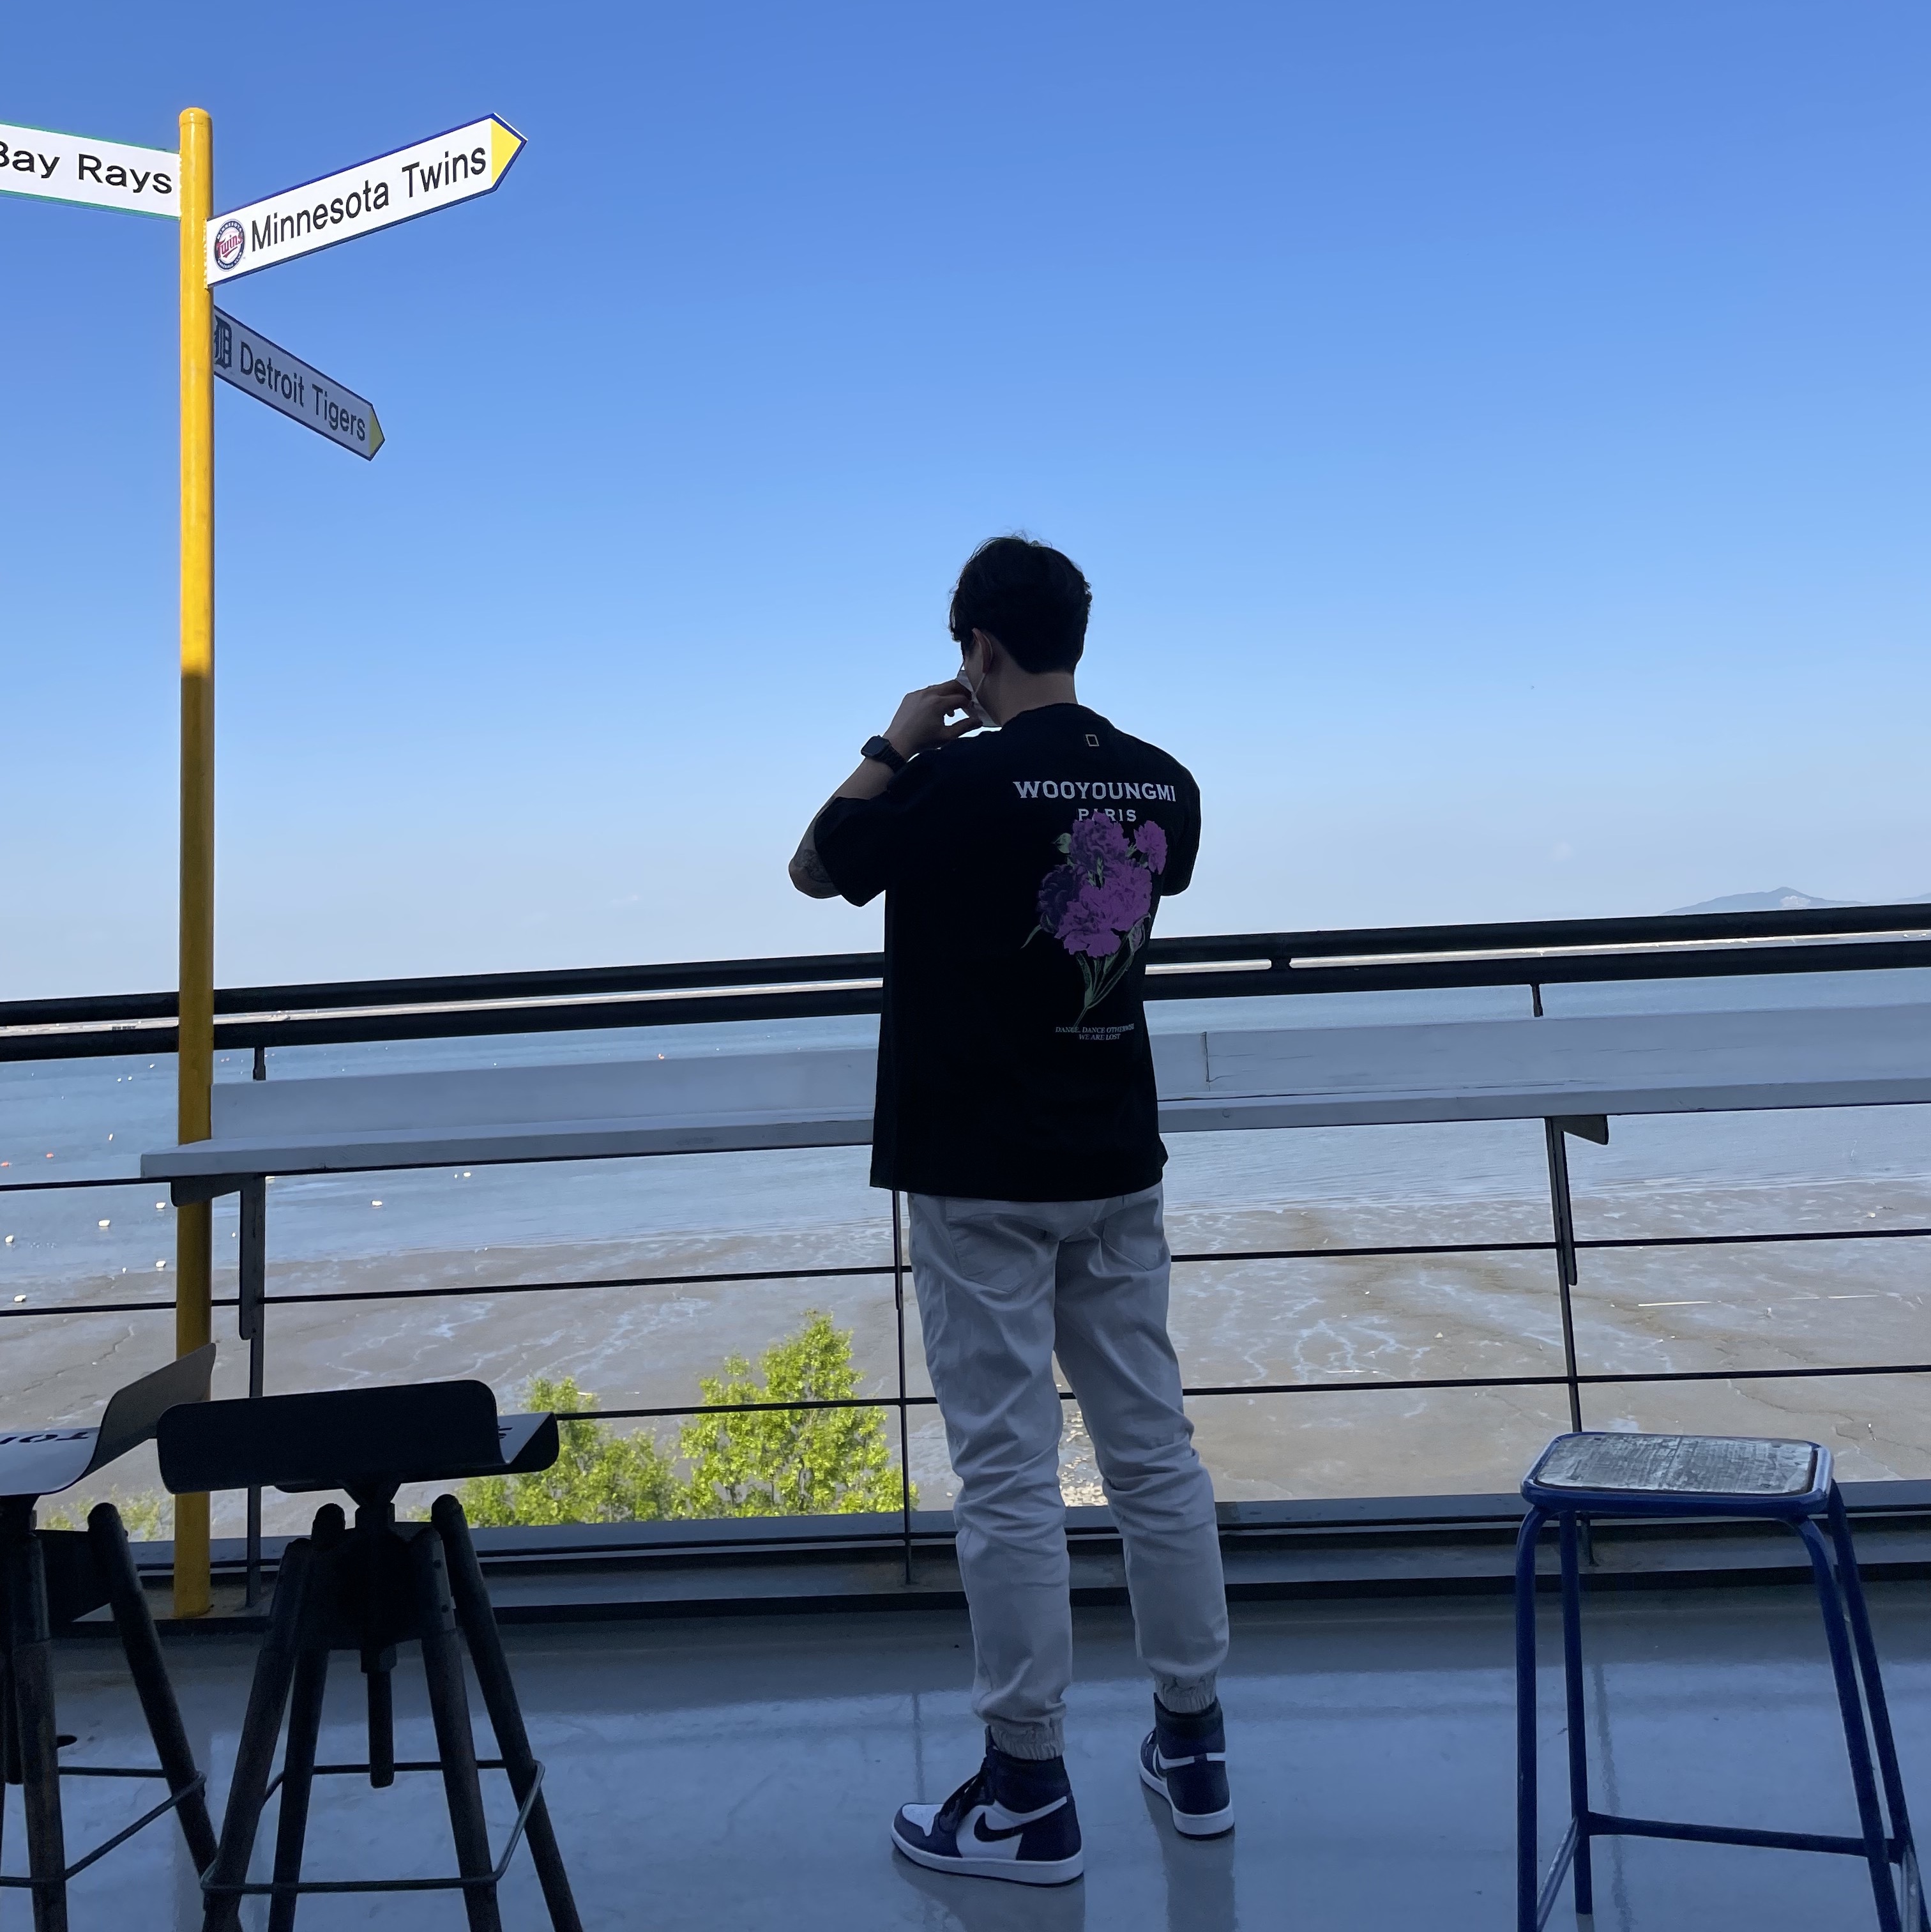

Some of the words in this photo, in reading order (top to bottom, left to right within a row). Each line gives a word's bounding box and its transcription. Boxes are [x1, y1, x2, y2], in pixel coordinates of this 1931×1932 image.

[78, 153, 172, 194] Rays
[252, 179, 390, 252] Minnesota
[402, 147, 487, 198] Twins
[216, 232, 243, 259] Twins
[240, 340, 305, 407] Detroit
[312, 384, 366, 441] Tigers
[1013, 780, 1176, 802] WOOYOUNGMI
